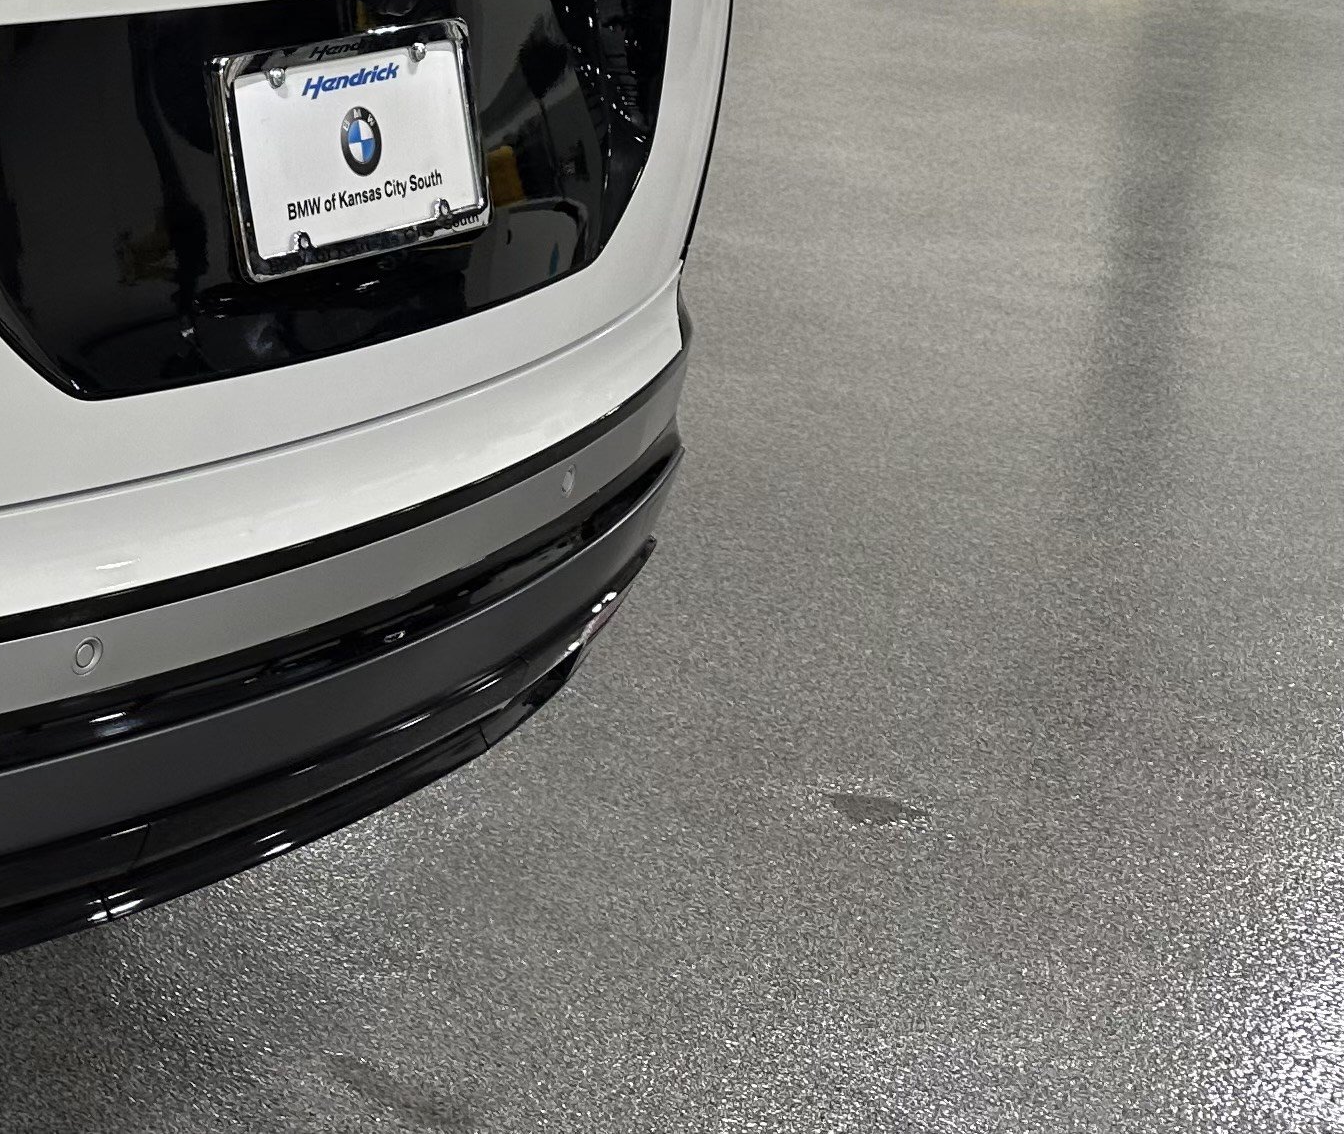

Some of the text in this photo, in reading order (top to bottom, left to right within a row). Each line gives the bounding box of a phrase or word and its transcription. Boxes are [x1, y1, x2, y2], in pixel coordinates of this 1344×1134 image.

[301, 62, 399, 100] Hendrick
[287, 168, 443, 221] BMW of Kansas City South
